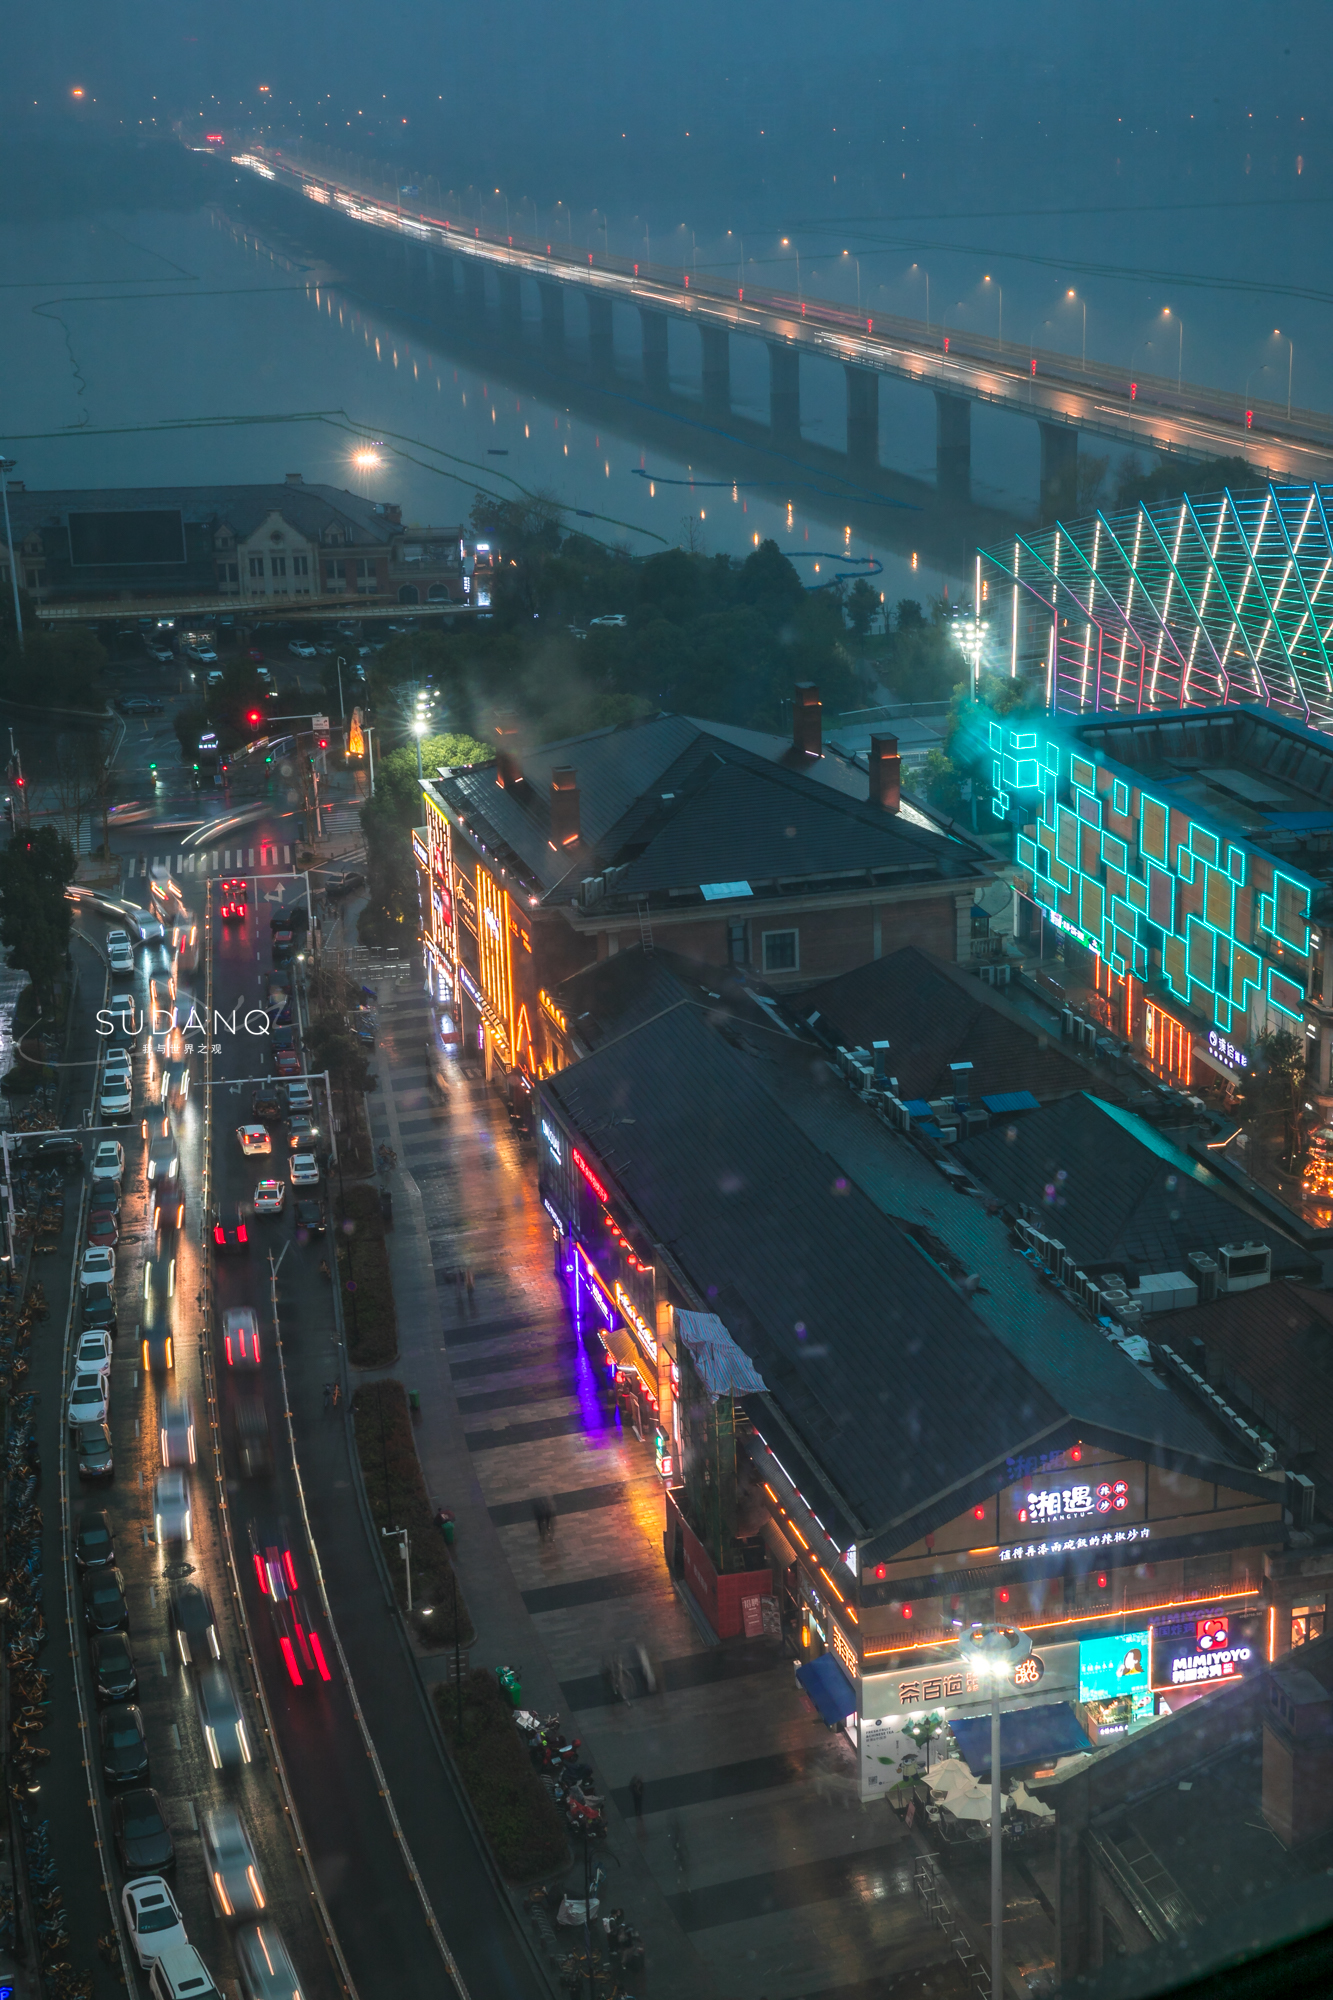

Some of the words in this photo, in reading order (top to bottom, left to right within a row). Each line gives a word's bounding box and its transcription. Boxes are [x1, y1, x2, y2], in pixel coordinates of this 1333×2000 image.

[1027, 1485, 1096, 1519] 湘遇
[1040, 1511, 1085, 1523] XIANGYU
[1172, 1648, 1251, 1671] MIMIYOYO
[899, 1673, 963, 1704] 茶百道
